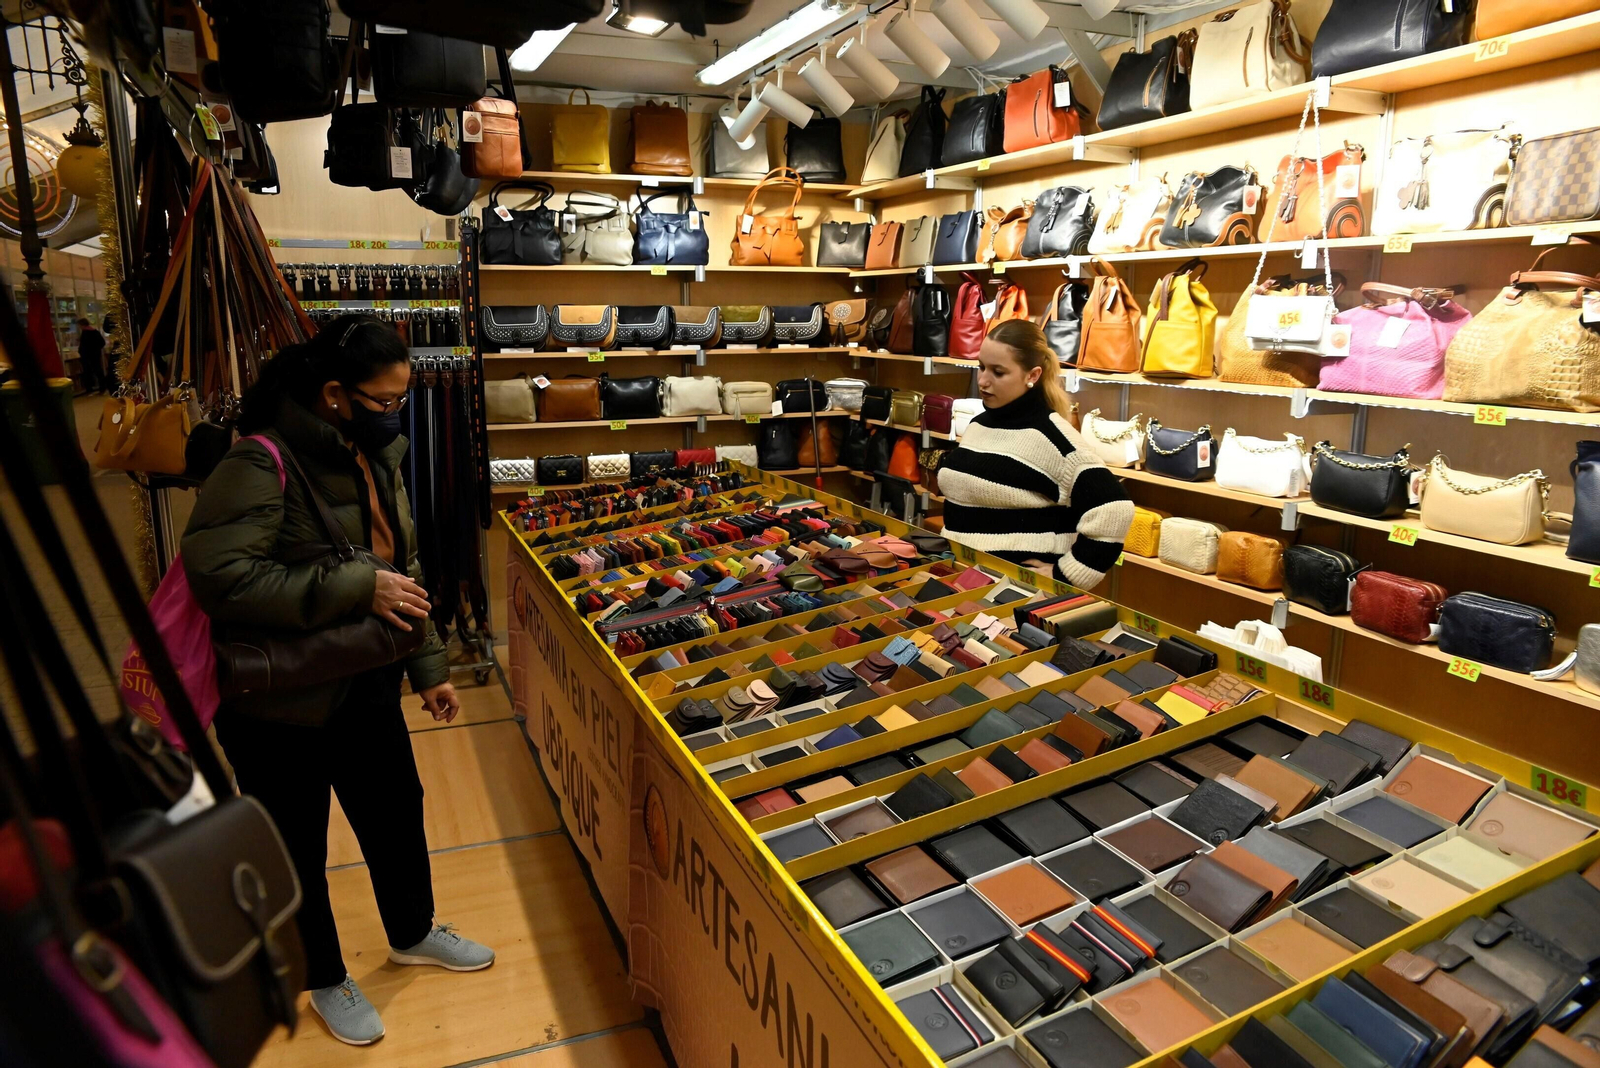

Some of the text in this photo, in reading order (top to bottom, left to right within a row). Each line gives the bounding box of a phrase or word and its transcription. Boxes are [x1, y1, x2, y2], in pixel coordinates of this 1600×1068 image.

[1480, 41, 1506, 57] 70€
[201, 108, 217, 138] 25€
[268, 239, 280, 248] 8€
[350, 241, 366, 249] 18€
[371, 241, 386, 249] 20€
[425, 241, 440, 249] 20€
[443, 242, 458, 250] 24€
[1387, 237, 1409, 250] 65€
[302, 301, 318, 309] 18€
[322, 301, 337, 309] 15€
[428, 300, 443, 308] 10€
[445, 300, 460, 308] 10€
[1279, 312, 1300, 325] 45€
[453, 347, 469, 355] 12€
[1477, 407, 1503, 423] 55€
[1392, 527, 1415, 543] 40€
[962, 547, 975, 561] 12€
[1019, 568, 1036, 586] 12€
[1136, 615, 1157, 636] 15€
[1238, 656, 1264, 680] 15€
[1451, 659, 1477, 678] 35€
[1301, 680, 1331, 706] 18€
[570, 667, 587, 729] EN
[590, 686, 625, 788] PIEL
[1536, 772, 1582, 807] 18€
